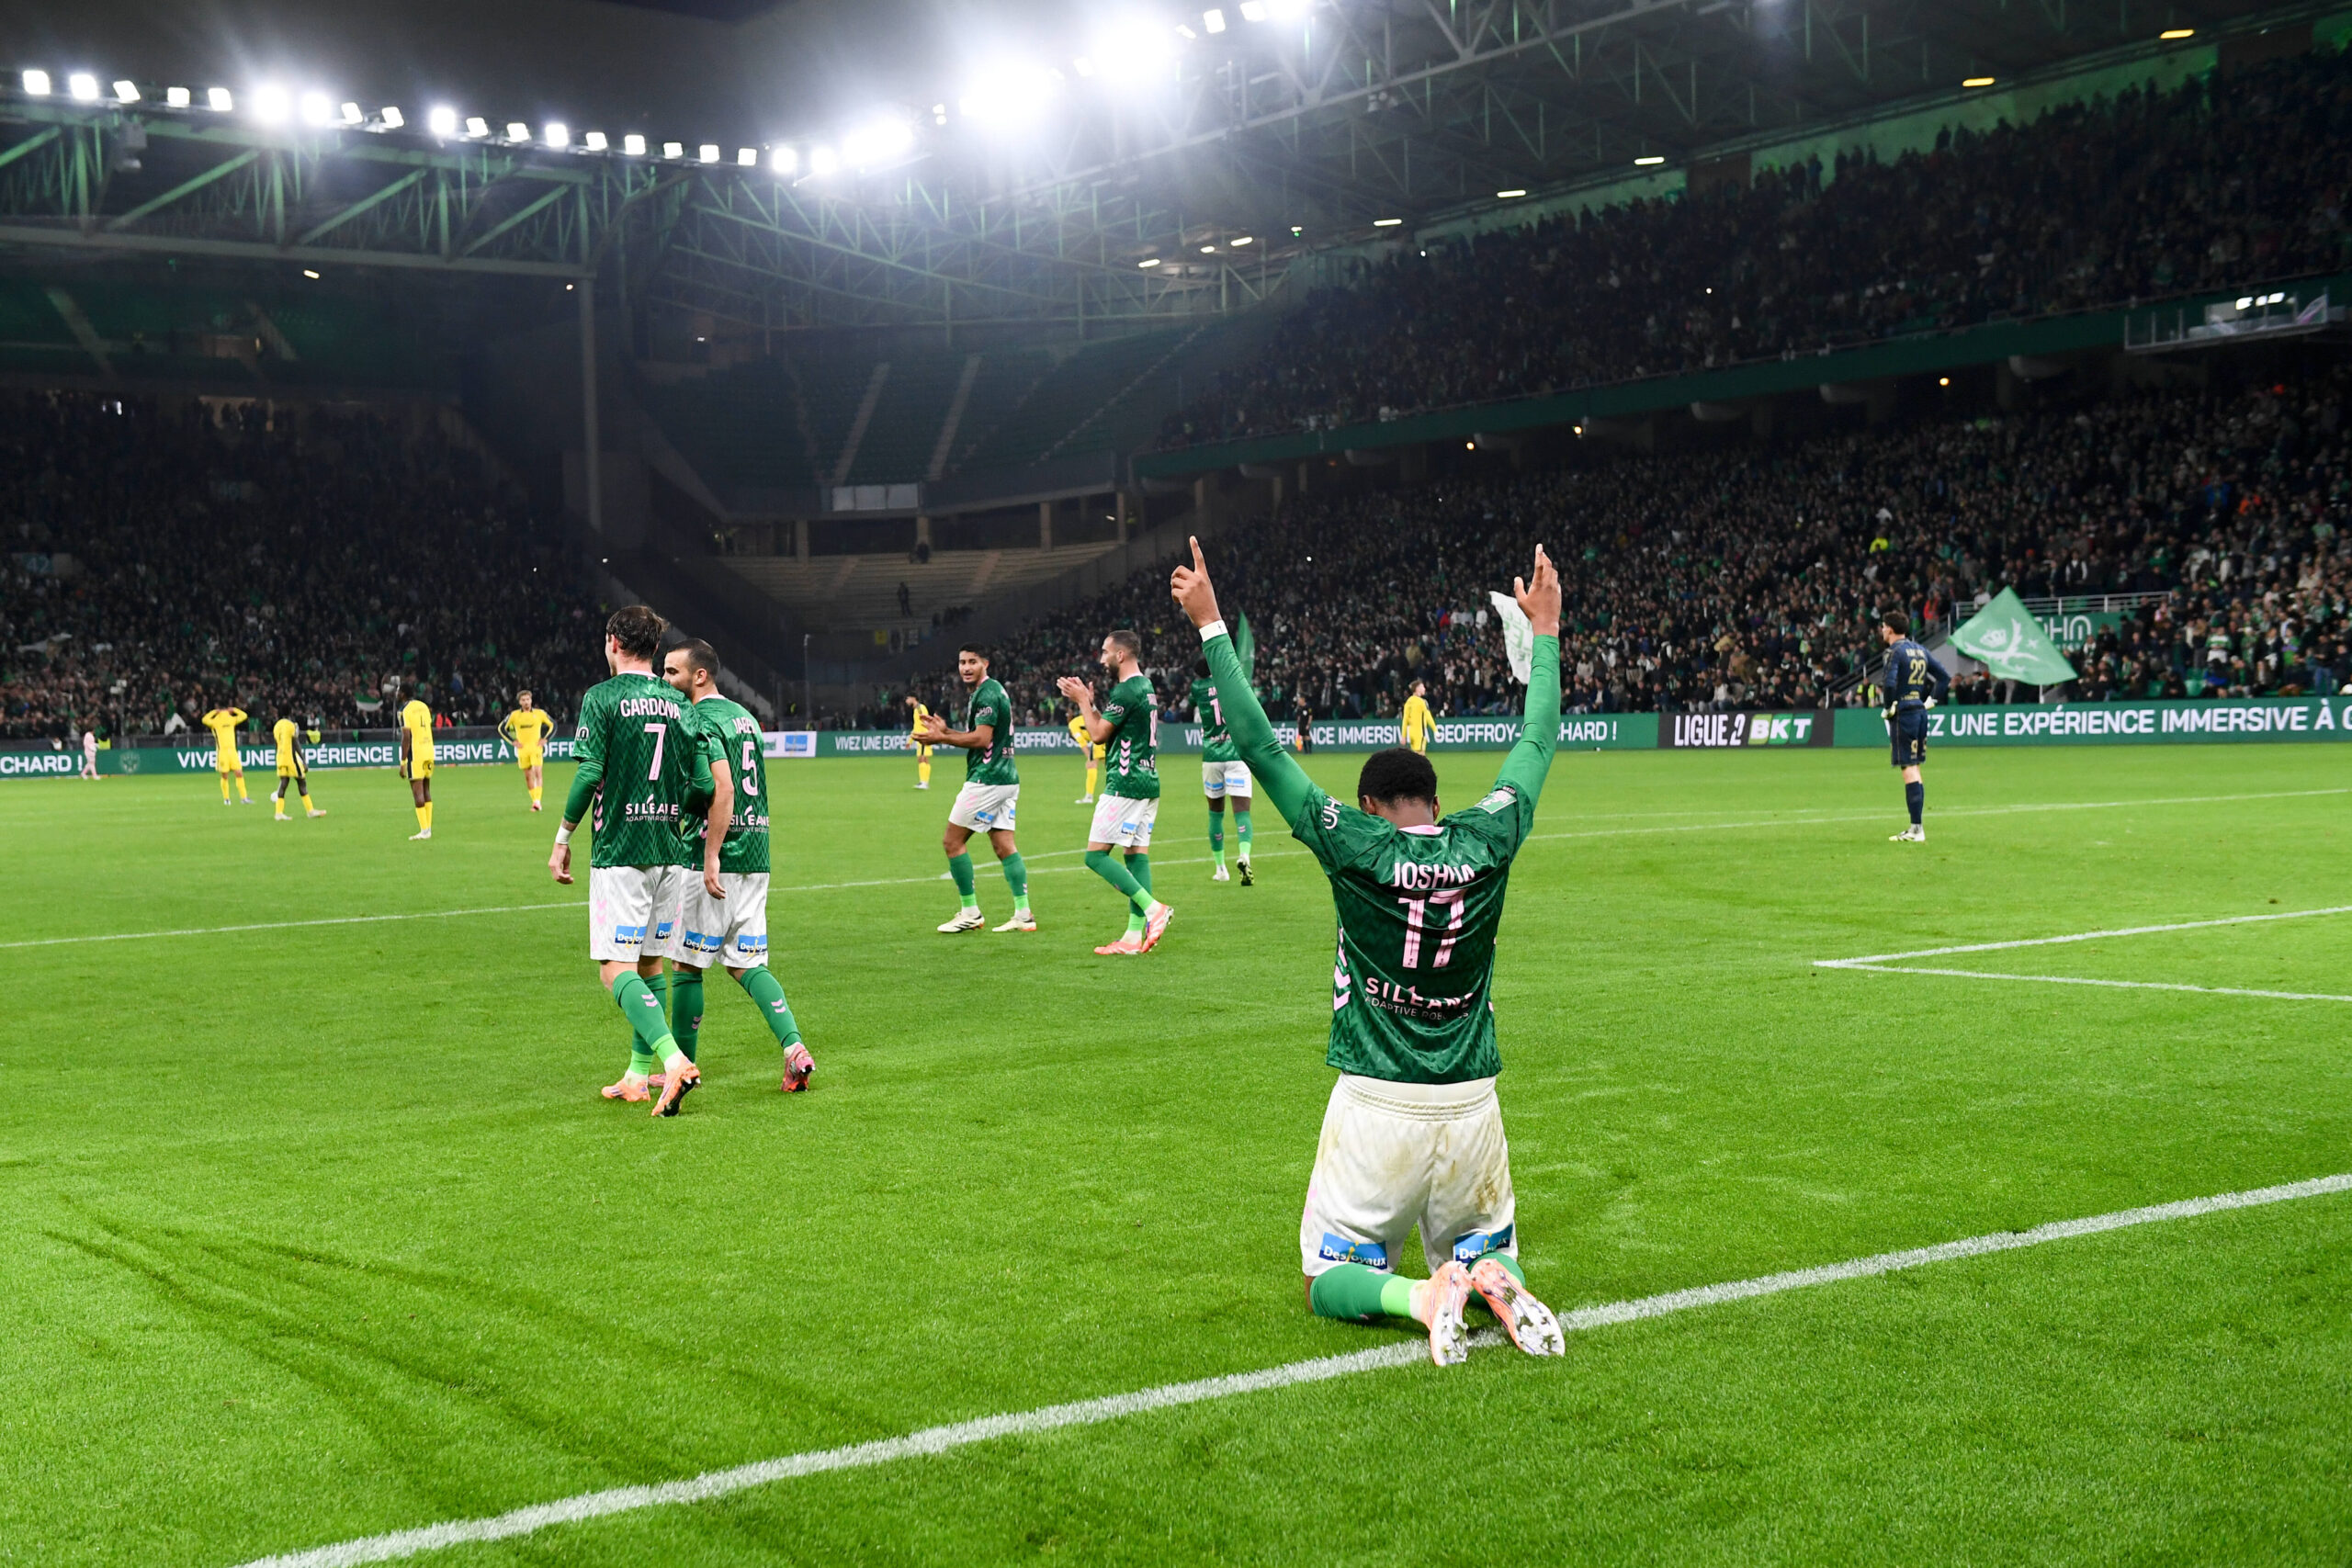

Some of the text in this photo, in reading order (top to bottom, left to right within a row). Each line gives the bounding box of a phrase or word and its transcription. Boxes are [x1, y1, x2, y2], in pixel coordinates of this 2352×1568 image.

[1907, 658, 1927, 685] 22
[620, 698, 681, 719] CARDONA
[1951, 713, 1998, 736] UNE
[2005, 705, 2155, 736] EXPÉRIENCE
[2162, 705, 2309, 733] IMMERSIVE
[2314, 698, 2335, 730] À
[835, 736, 861, 750] VIVEZ
[863, 736, 880, 750] UNE
[1674, 714, 1728, 747] LIGUE
[1751, 717, 1812, 740] BKT
[176, 750, 218, 769] VIVE
[302, 743, 393, 764] PÉRIENCE
[644, 722, 667, 781] 7
[742, 741, 758, 796] 5
[1398, 886, 1468, 969] 17
